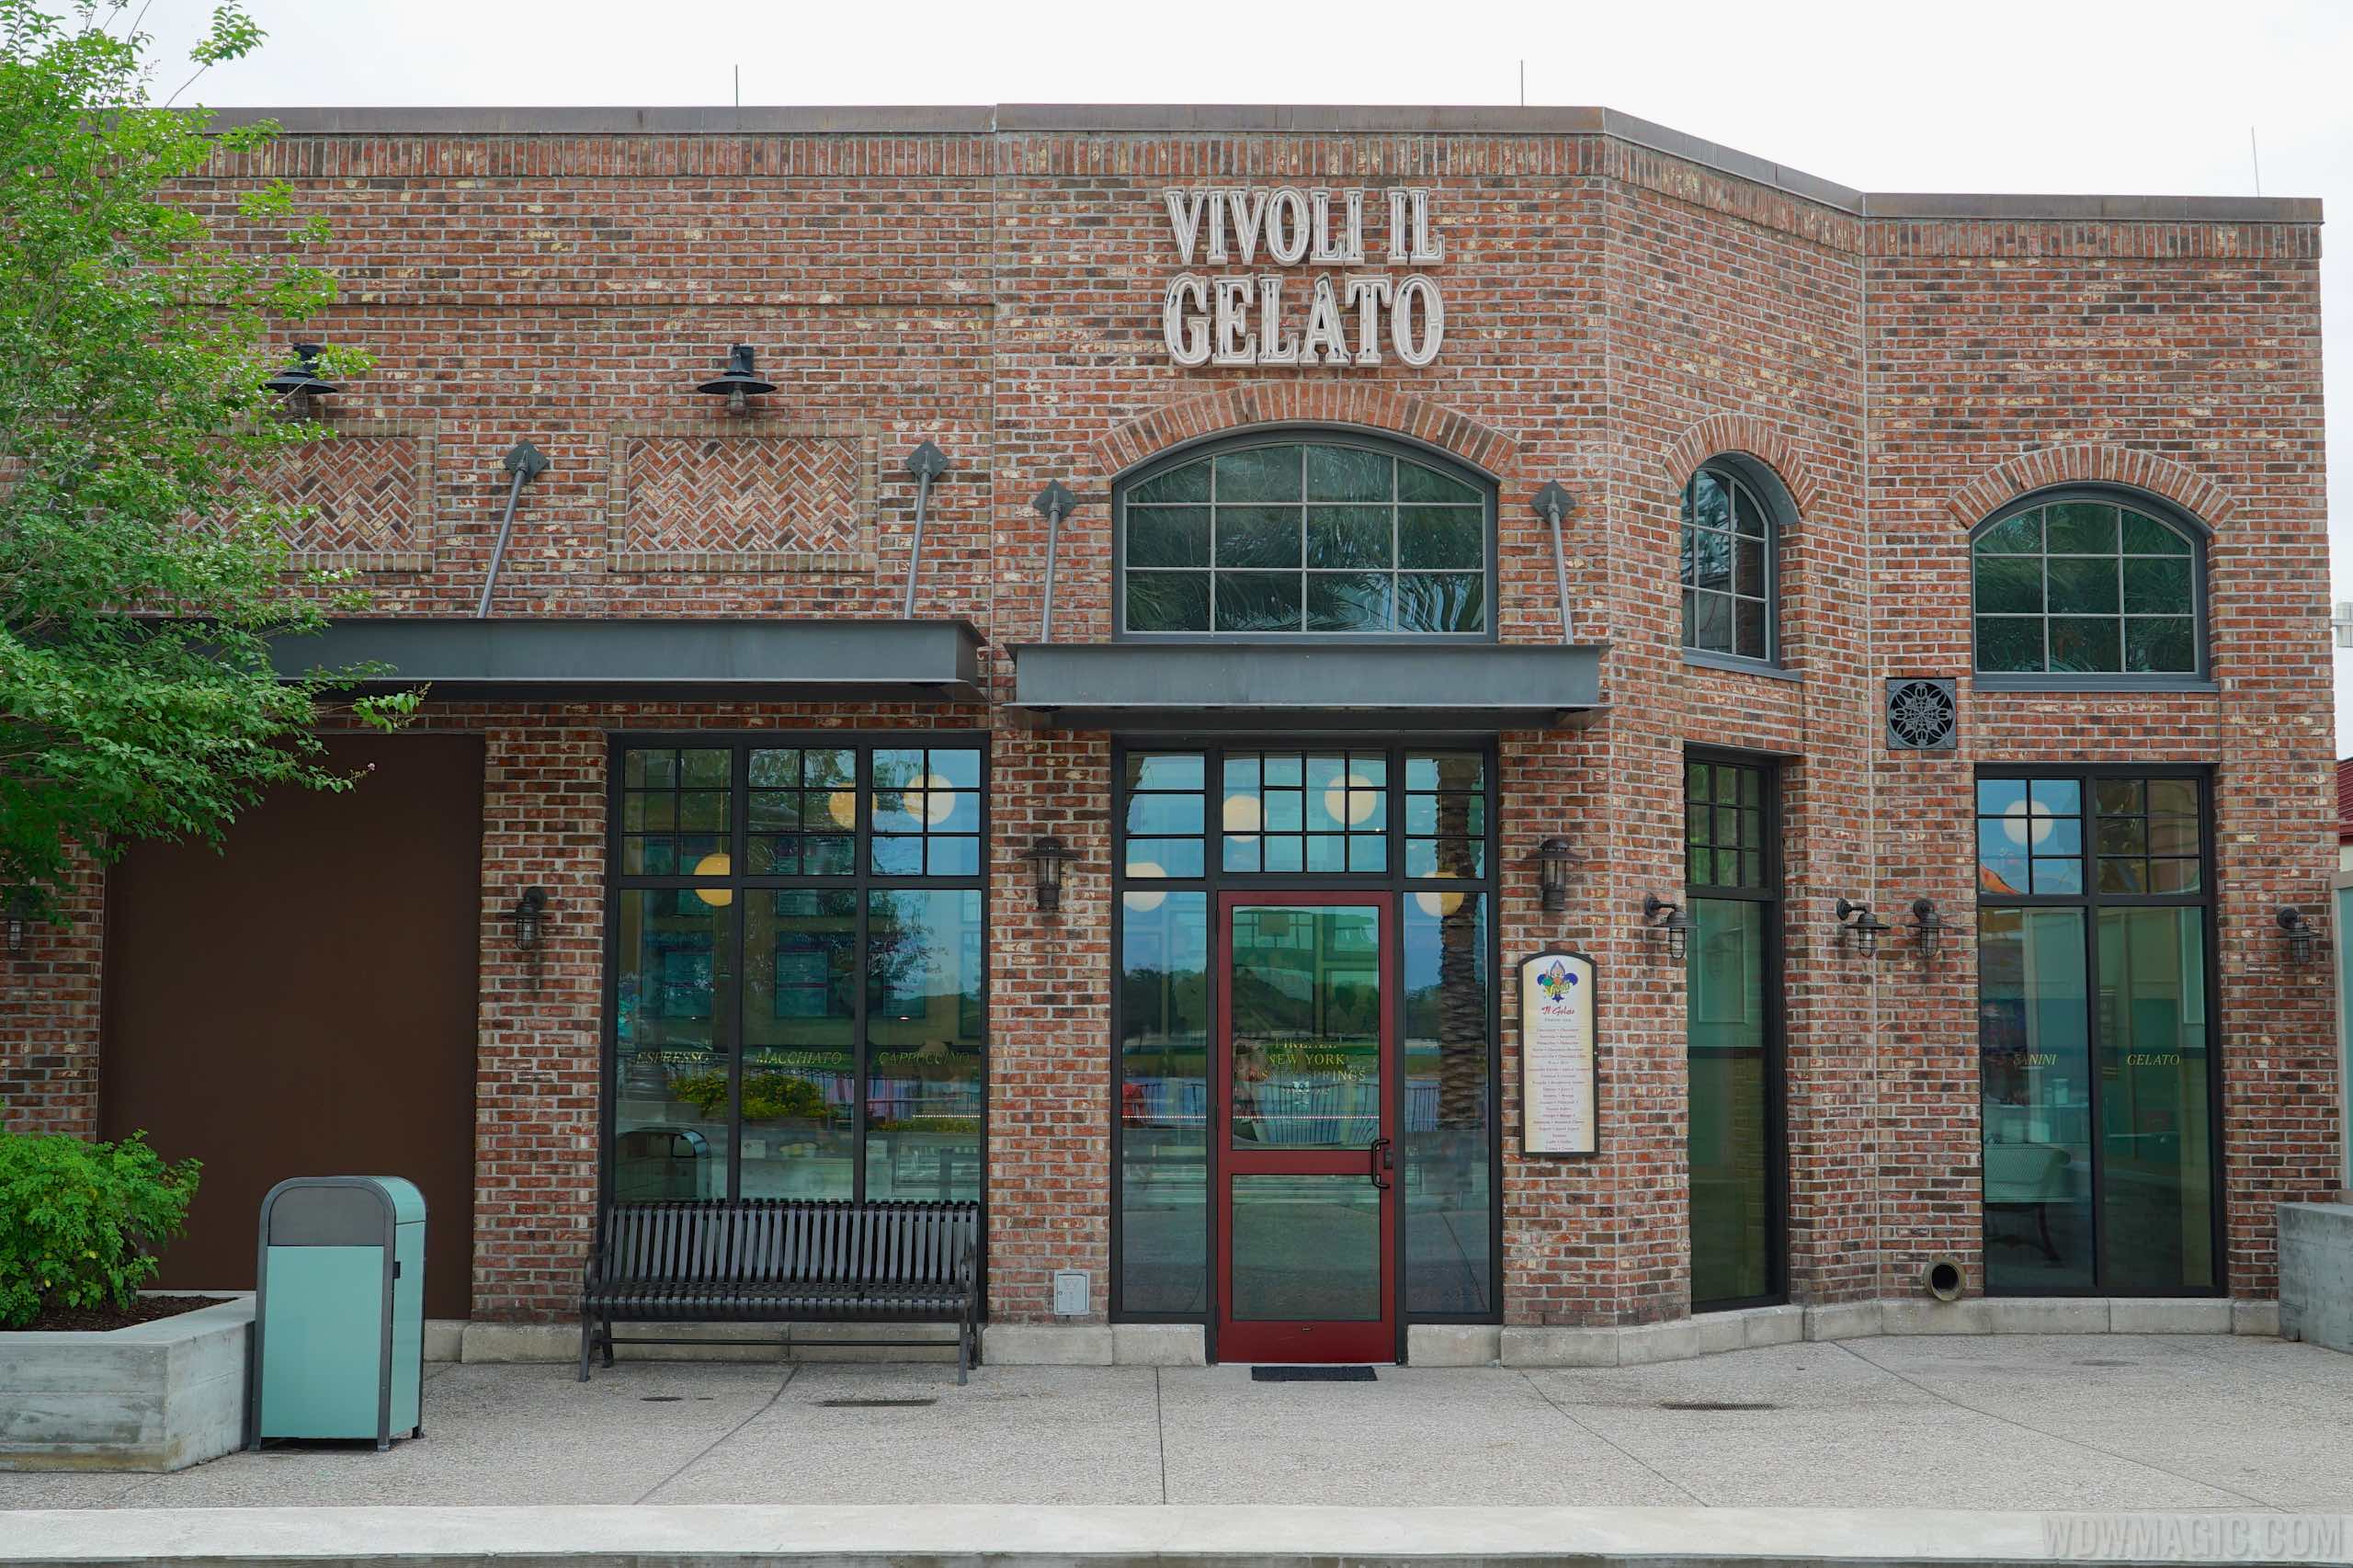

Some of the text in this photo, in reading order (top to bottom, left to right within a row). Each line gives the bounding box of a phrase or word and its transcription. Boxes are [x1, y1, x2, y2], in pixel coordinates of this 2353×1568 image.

[1163, 186, 1446, 266] VIVOLI IL
[1163, 272, 1444, 367] GELATO
[756, 1051, 842, 1064] MACCHIATO
[879, 1051, 971, 1064] CAPPUCCINO
[1267, 1053, 1345, 1065] NEW YORK
[2127, 1053, 2180, 1066] GELATO
